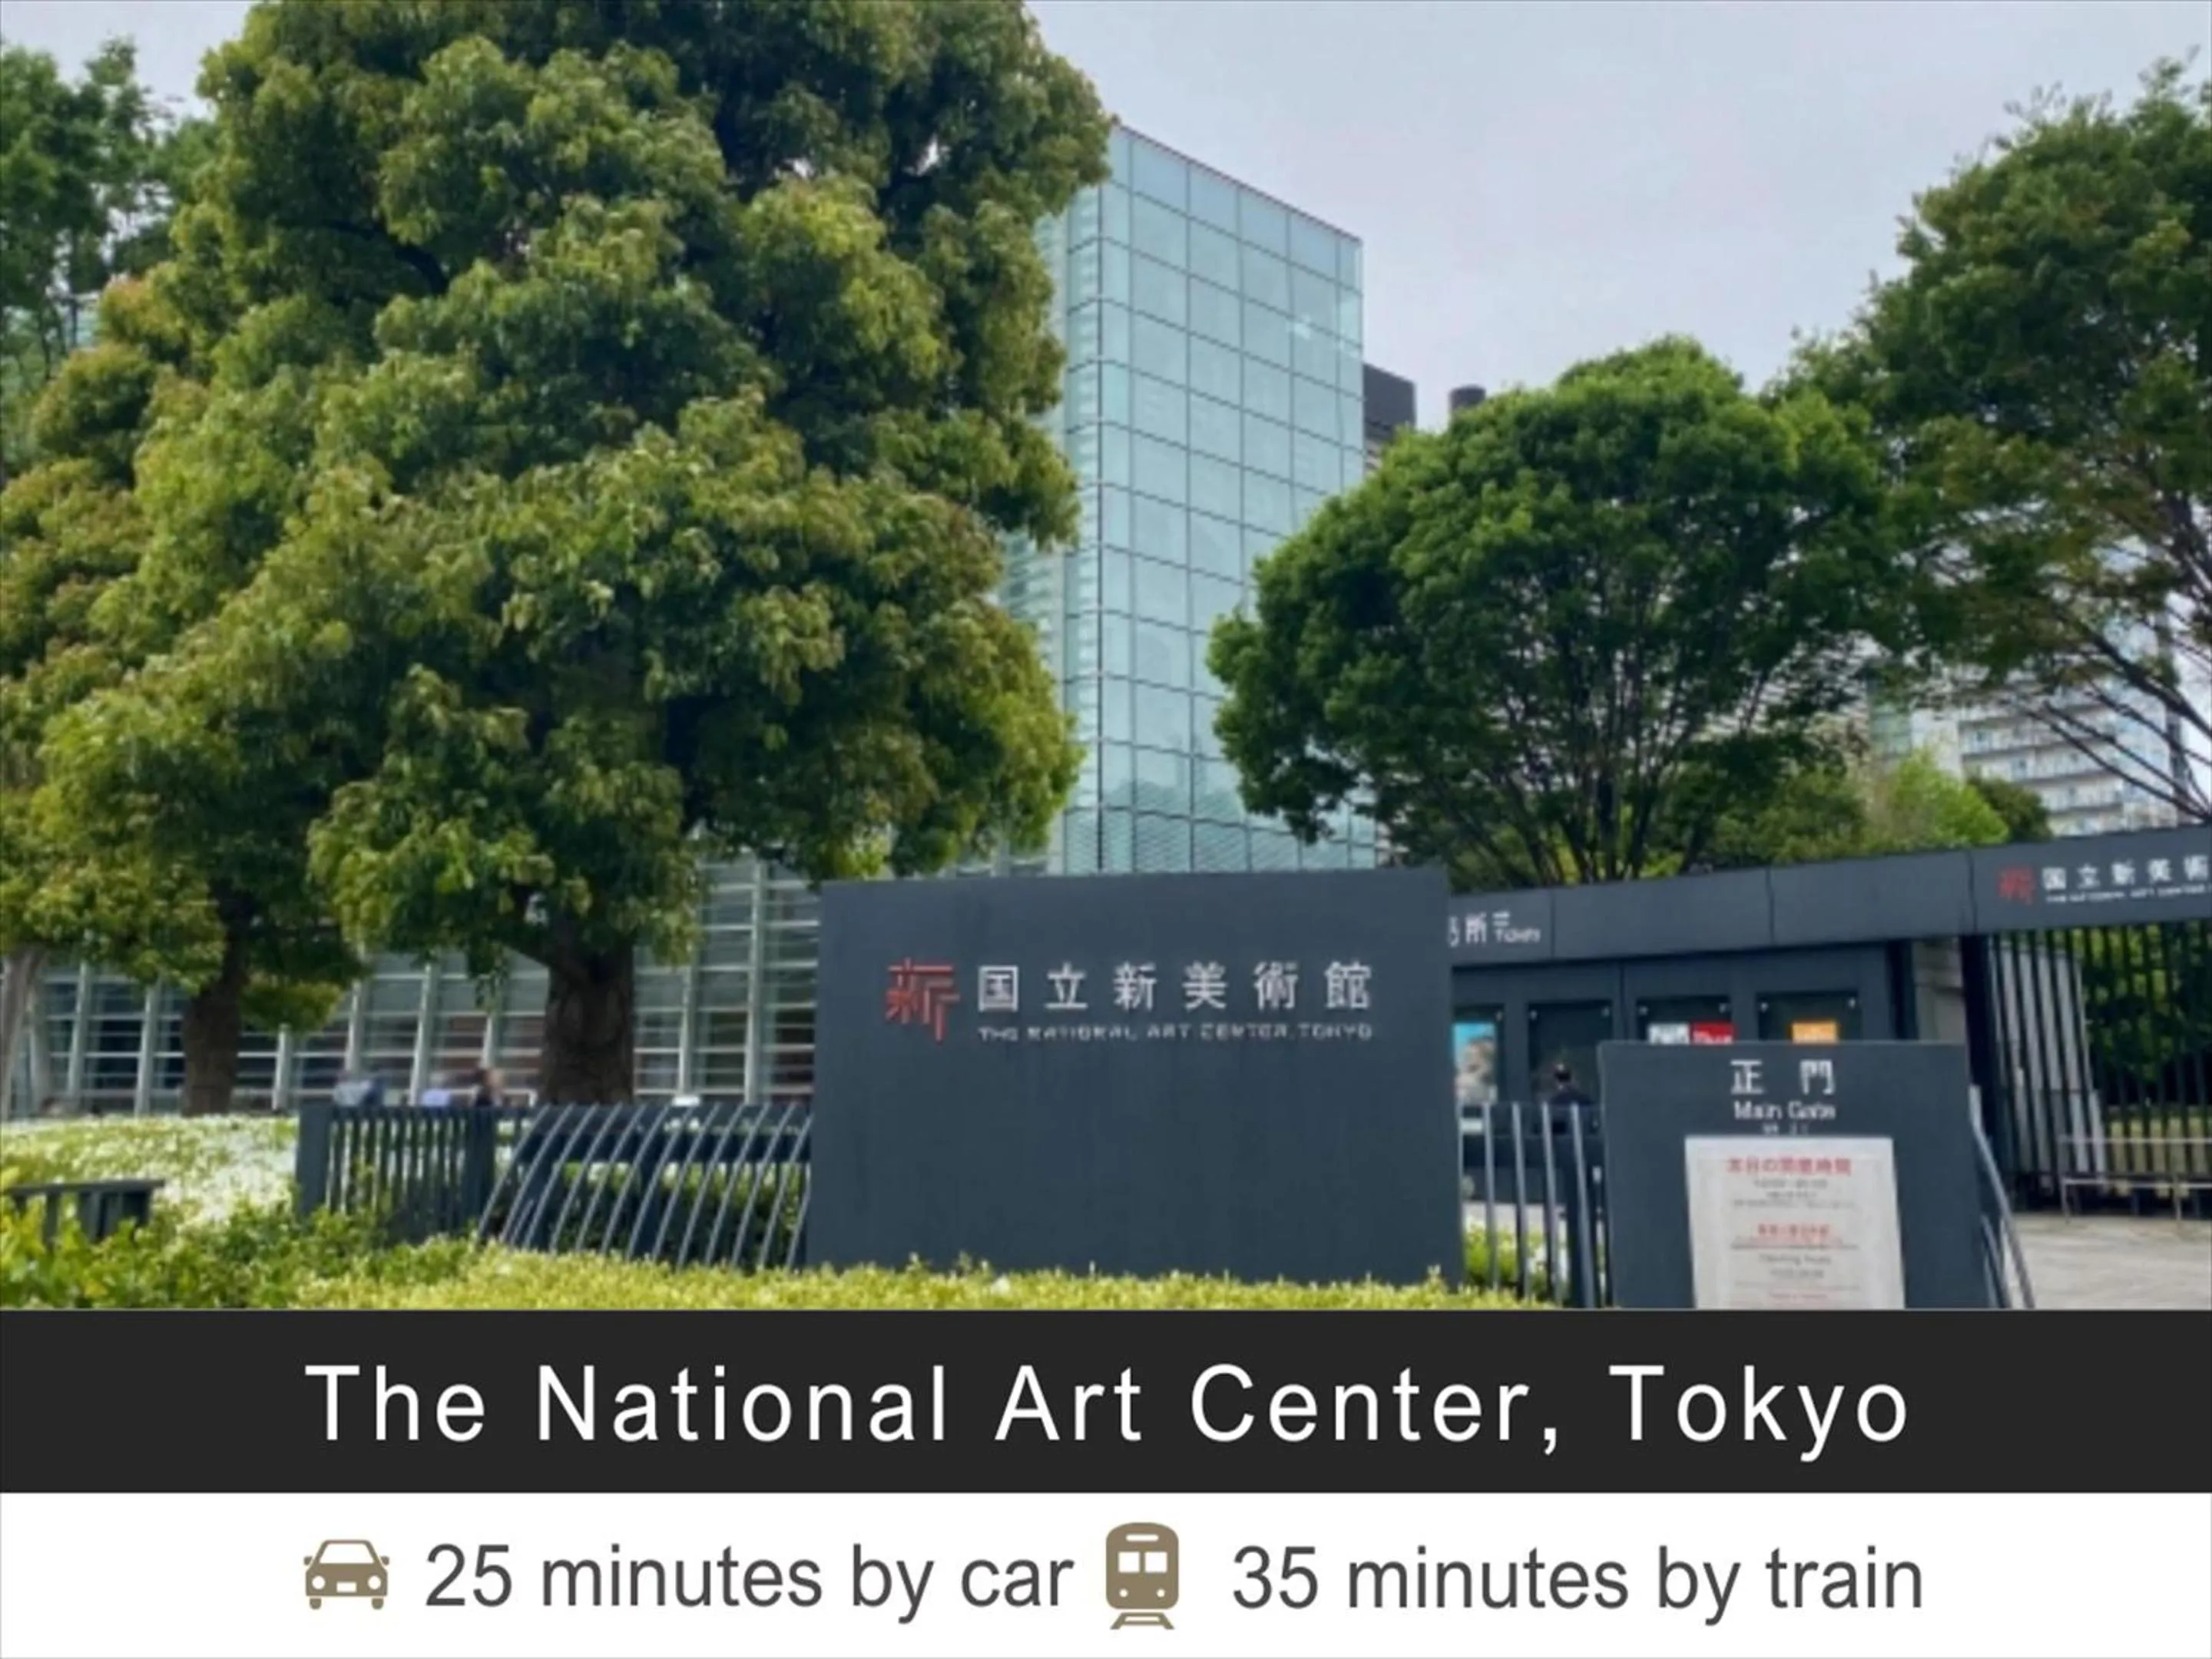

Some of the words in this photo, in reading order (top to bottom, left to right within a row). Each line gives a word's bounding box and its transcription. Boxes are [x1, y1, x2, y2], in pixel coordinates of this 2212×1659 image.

[977, 960, 1373, 1012] 国立新美術館
[978, 1026, 1018, 1042] THE
[1027, 1025, 1138, 1042] NATIONAL
[1146, 1023, 1191, 1040] ART
[1298, 1022, 1373, 1041] TOKYO
[1730, 1058, 1836, 1095] 正門
[1734, 1100, 1783, 1120] Main
[1787, 1100, 1836, 1120] Gate
